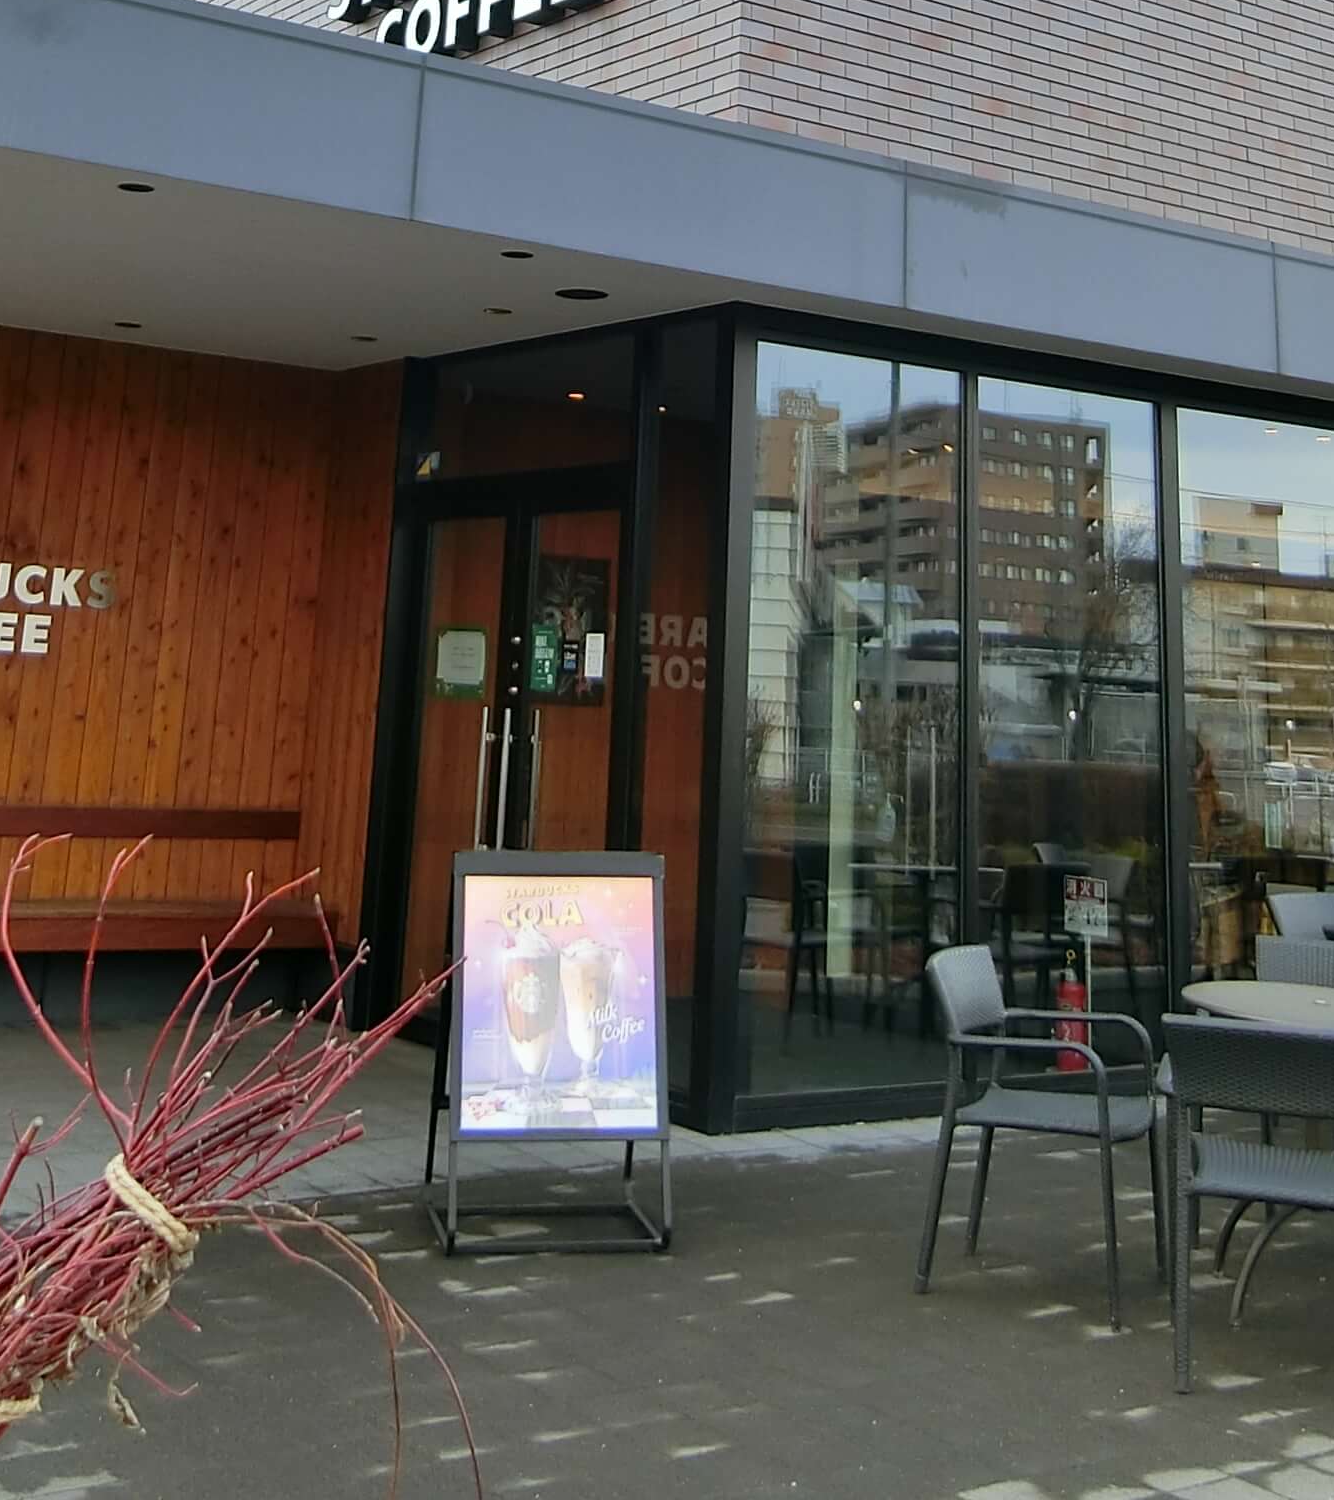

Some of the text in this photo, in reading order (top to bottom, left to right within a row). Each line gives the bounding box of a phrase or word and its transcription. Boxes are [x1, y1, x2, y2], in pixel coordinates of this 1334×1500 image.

[500, 899, 585, 928] COLA
[587, 999, 619, 1028] Milk
[602, 1015, 646, 1045] Coffee
